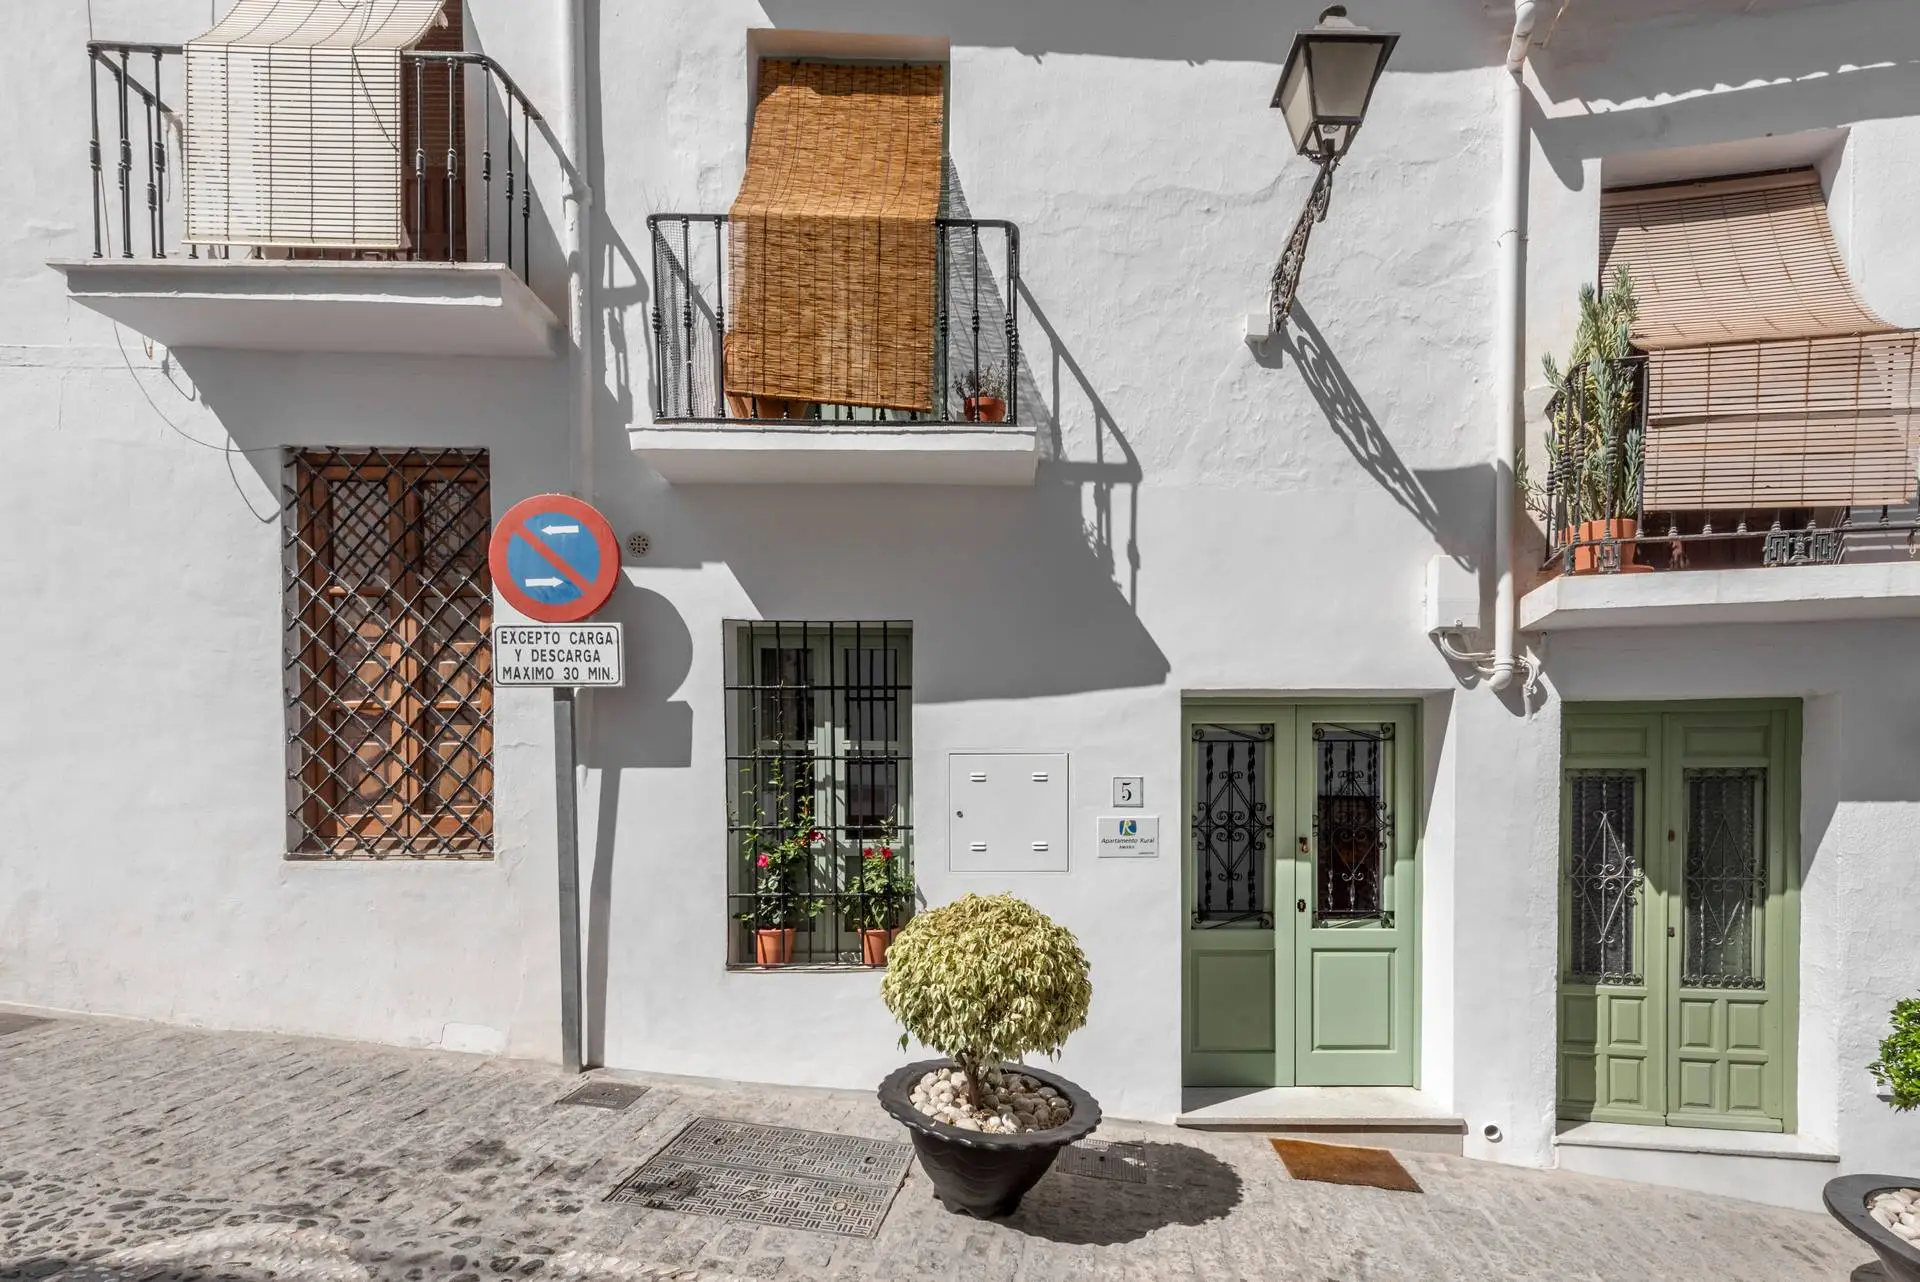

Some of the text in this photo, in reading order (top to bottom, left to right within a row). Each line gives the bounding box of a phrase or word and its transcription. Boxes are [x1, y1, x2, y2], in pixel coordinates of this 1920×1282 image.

[501, 631, 613, 645] EXCEPTO CARGA
[515, 649, 601, 662] Y DESCARGA
[502, 667, 614, 680] MAXIMO 30 MIN.
[1121, 782, 1132, 801] 5
